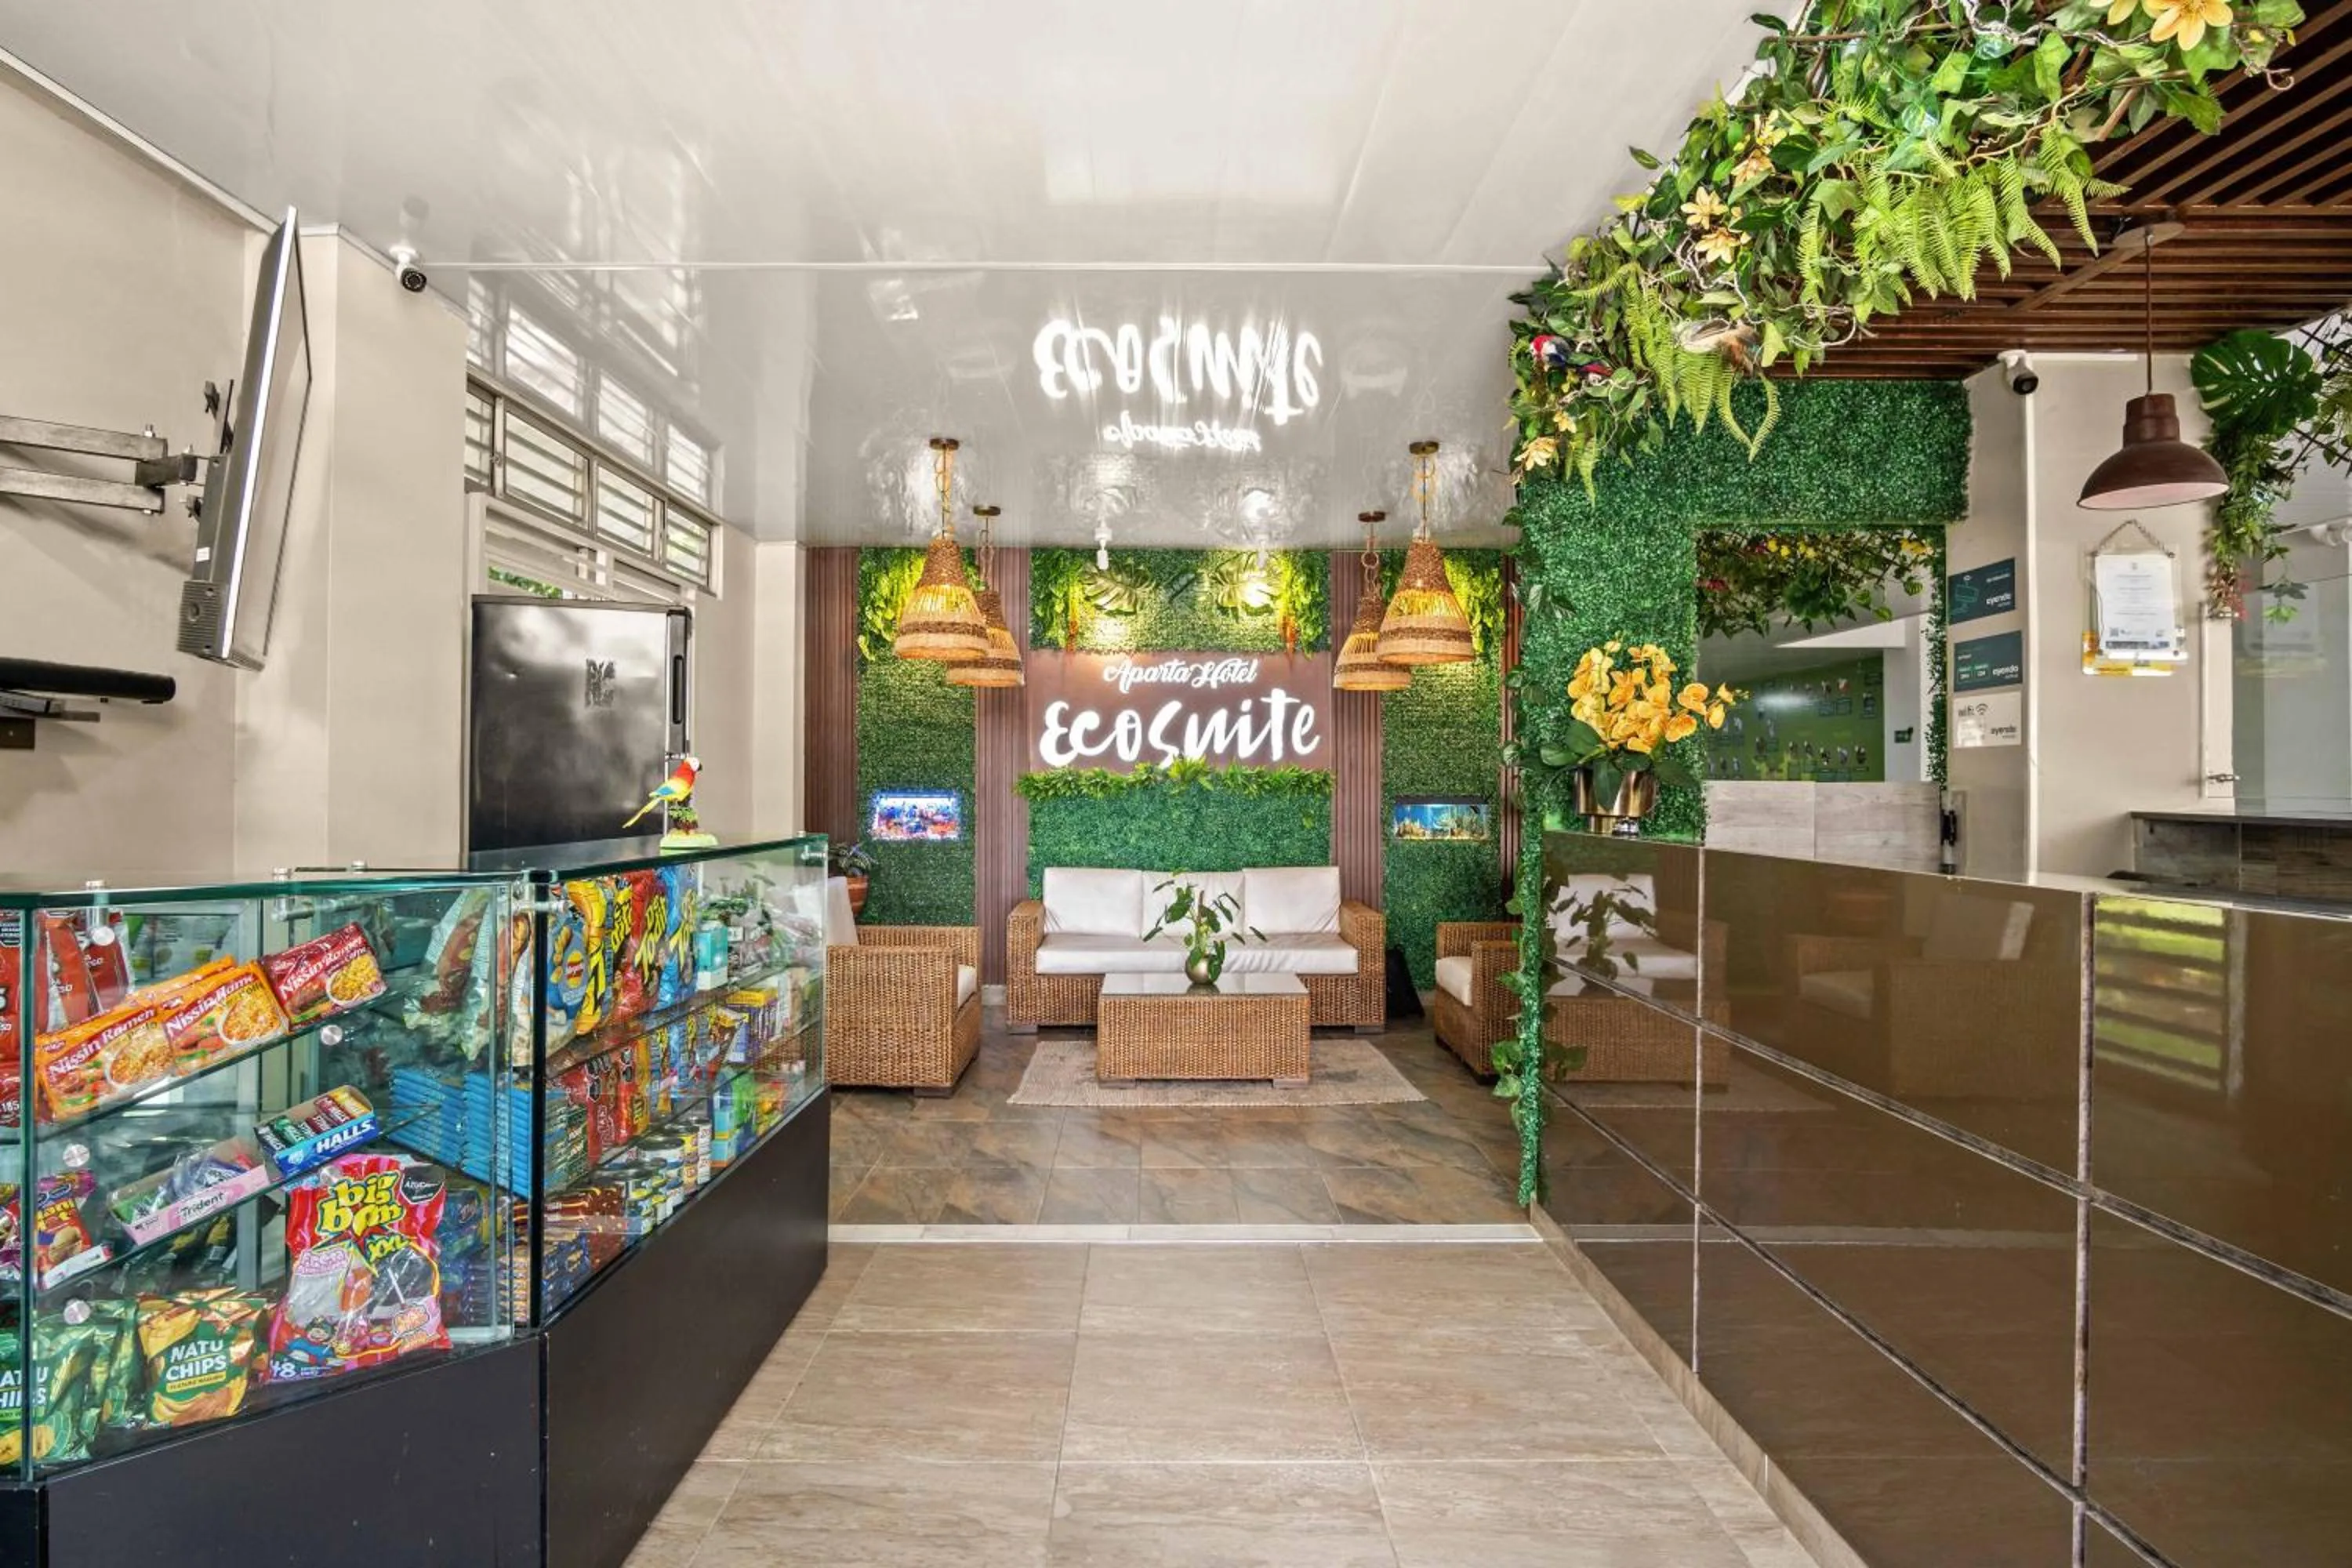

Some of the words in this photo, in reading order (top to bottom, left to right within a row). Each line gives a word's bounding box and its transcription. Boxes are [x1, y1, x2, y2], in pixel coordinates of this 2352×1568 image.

[1103, 659, 1190, 695] Aparta
[1190, 658, 1259, 689] Hotel
[315, 1119, 373, 1154] HALLS
[180, 1191, 224, 1218] Trident
[170, 1338, 223, 1363] NATU
[165, 1355, 227, 1381] CHIPS
[270, 1359, 296, 1377] 48
